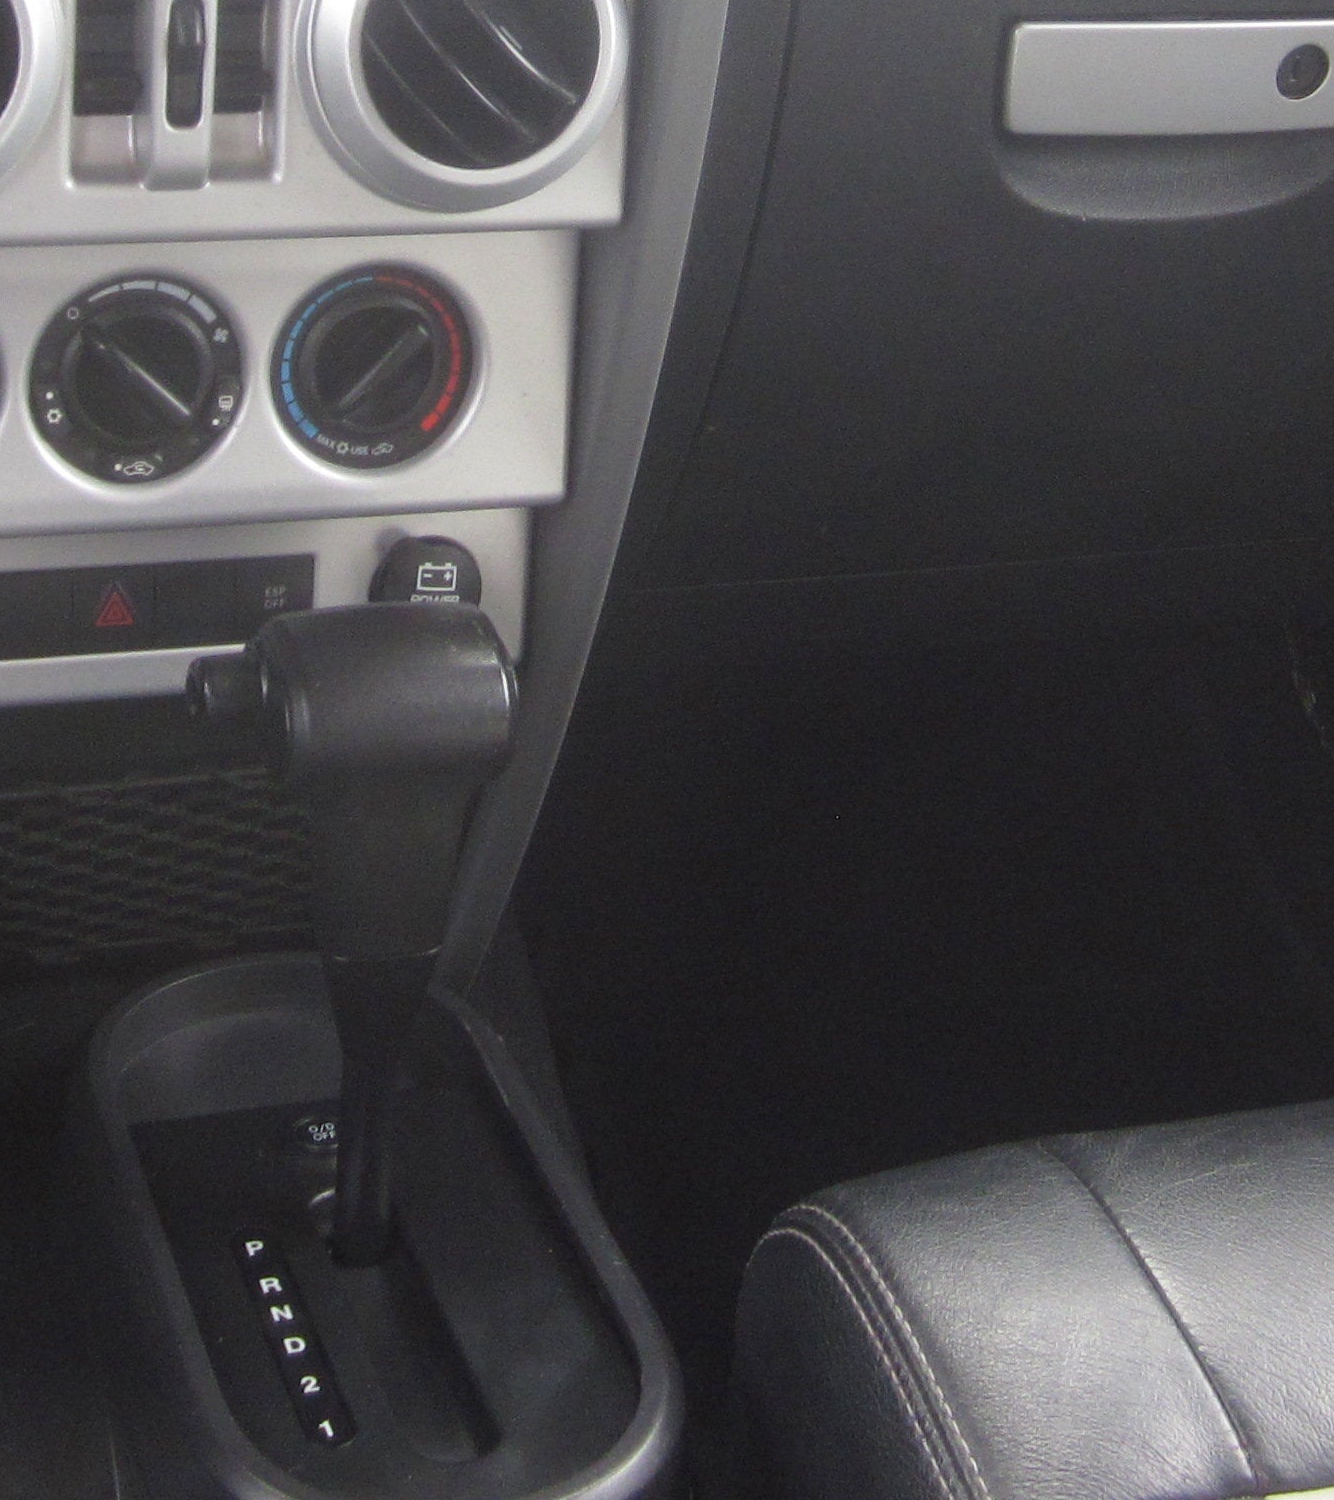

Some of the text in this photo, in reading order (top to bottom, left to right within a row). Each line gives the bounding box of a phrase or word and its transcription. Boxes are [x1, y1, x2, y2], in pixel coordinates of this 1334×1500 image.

[245, 1240, 264, 1257] P
[260, 1277, 283, 1295] R
[270, 1304, 294, 1322] N
[283, 1336, 306, 1354] D
[300, 1376, 320, 1394] 2
[318, 1420, 334, 1437] 1
